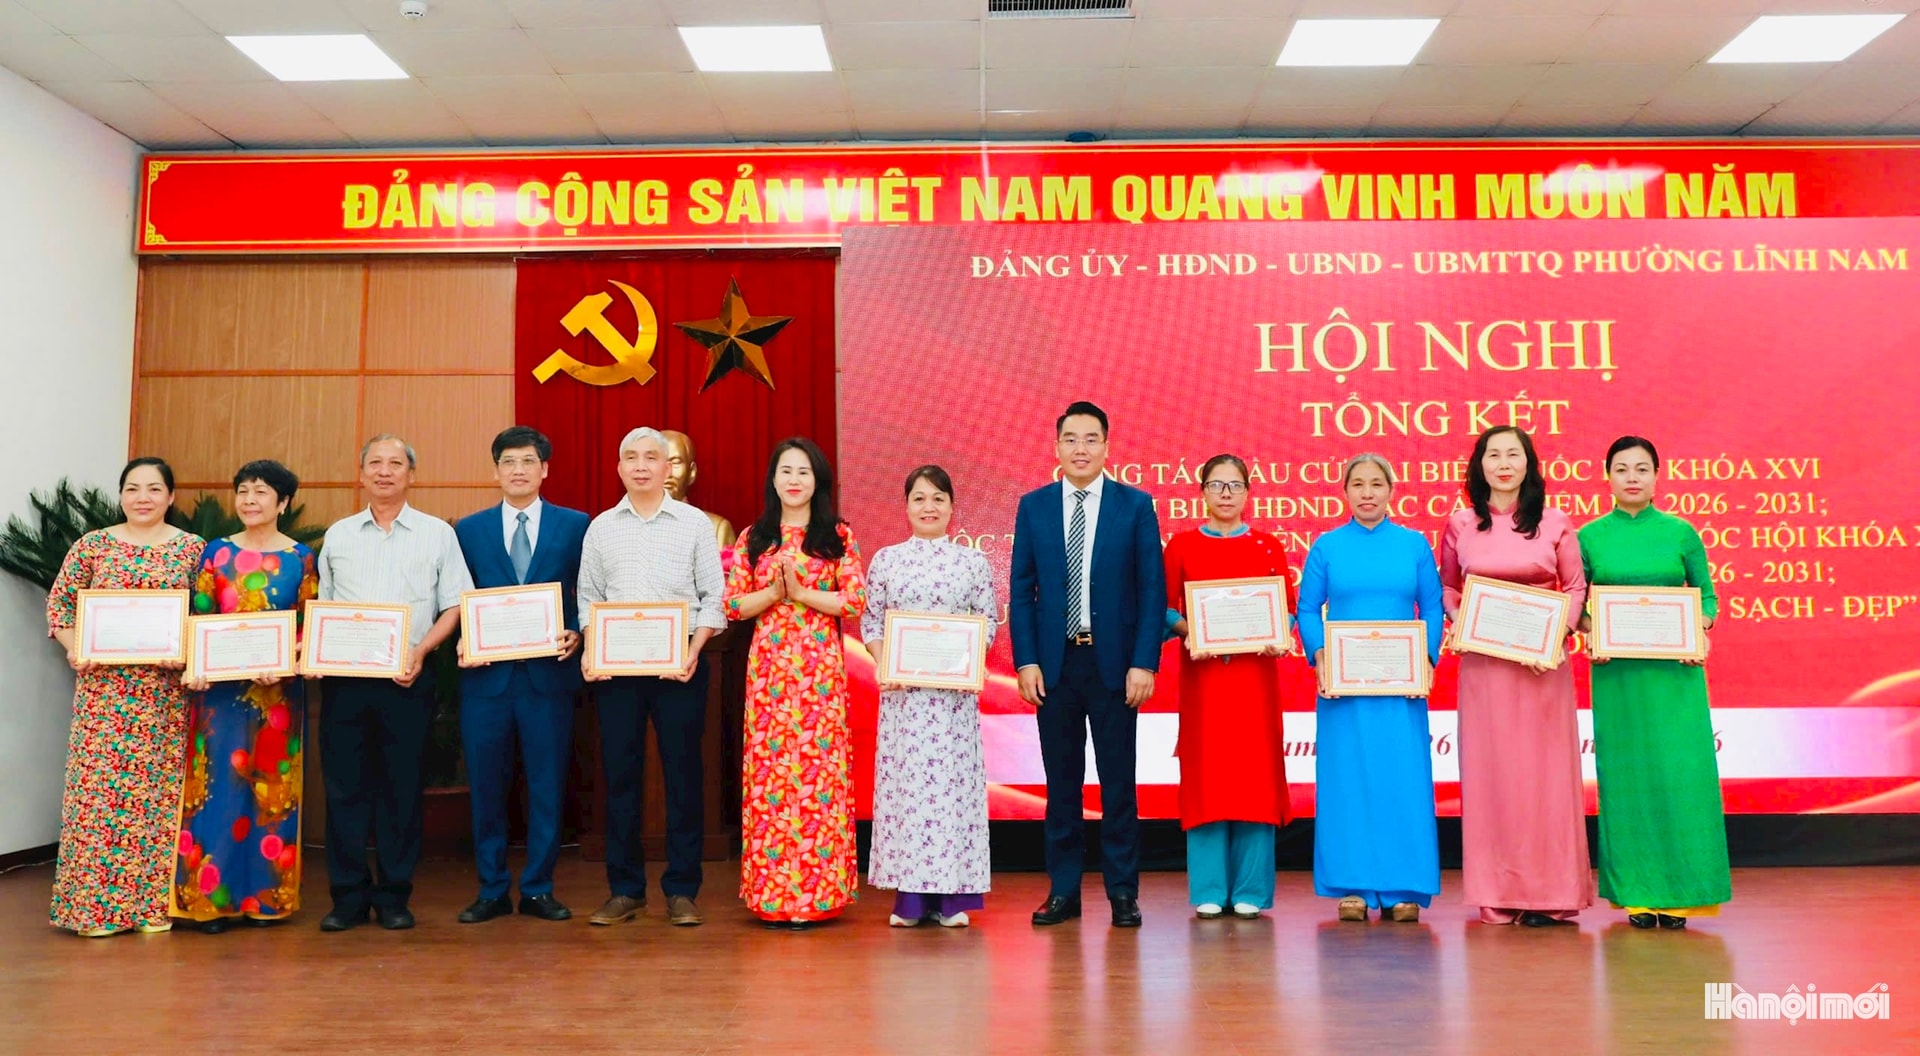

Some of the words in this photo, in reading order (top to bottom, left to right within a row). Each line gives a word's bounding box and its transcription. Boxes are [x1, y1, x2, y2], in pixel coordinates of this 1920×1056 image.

[342, 169, 495, 228] ĐẢNG
[516, 171, 668, 235] CỘNG
[688, 164, 804, 223] SẢN
[961, 176, 1092, 221] NAM
[1112, 174, 1303, 224] QUANG
[1321, 174, 1455, 219] VINH
[1475, 164, 1645, 219] MUÔN
[1666, 162, 1796, 218] NĂM
[970, 250, 1070, 279] ĐẢNG
[1081, 248, 1130, 277] ỦY
[1157, 253, 1257, 276] HĐND
[1286, 252, 1382, 275] UBND
[1413, 250, 1563, 277] UBMTTQ
[1573, 244, 1723, 273] PHƯỜNG
[1733, 244, 1818, 271] LĨNH
[1828, 248, 1908, 271] NAM
[1253, 307, 1397, 384] HỘI
[1415, 319, 1619, 382] NGHỊ
[1301, 391, 1451, 437] TỔNG
[1464, 390, 1570, 436] KẾT
[1249, 456, 1291, 484] ẦU
[1420, 454, 1469, 482] BIỂ
[1667, 453, 1758, 481] KHÓA
[1766, 457, 1821, 480] XVI
[1253, 496, 1345, 519] HĐND
[1427, 489, 1467, 518] CẤ
[1664, 493, 1728, 515] 2026
[1755, 492, 1829, 517] 2031;
[1751, 521, 1806, 553] HỘI
[1816, 520, 1908, 548] KHÓA
[1762, 561, 1836, 586] 2031;
[1730, 595, 1815, 623] SẠCH
